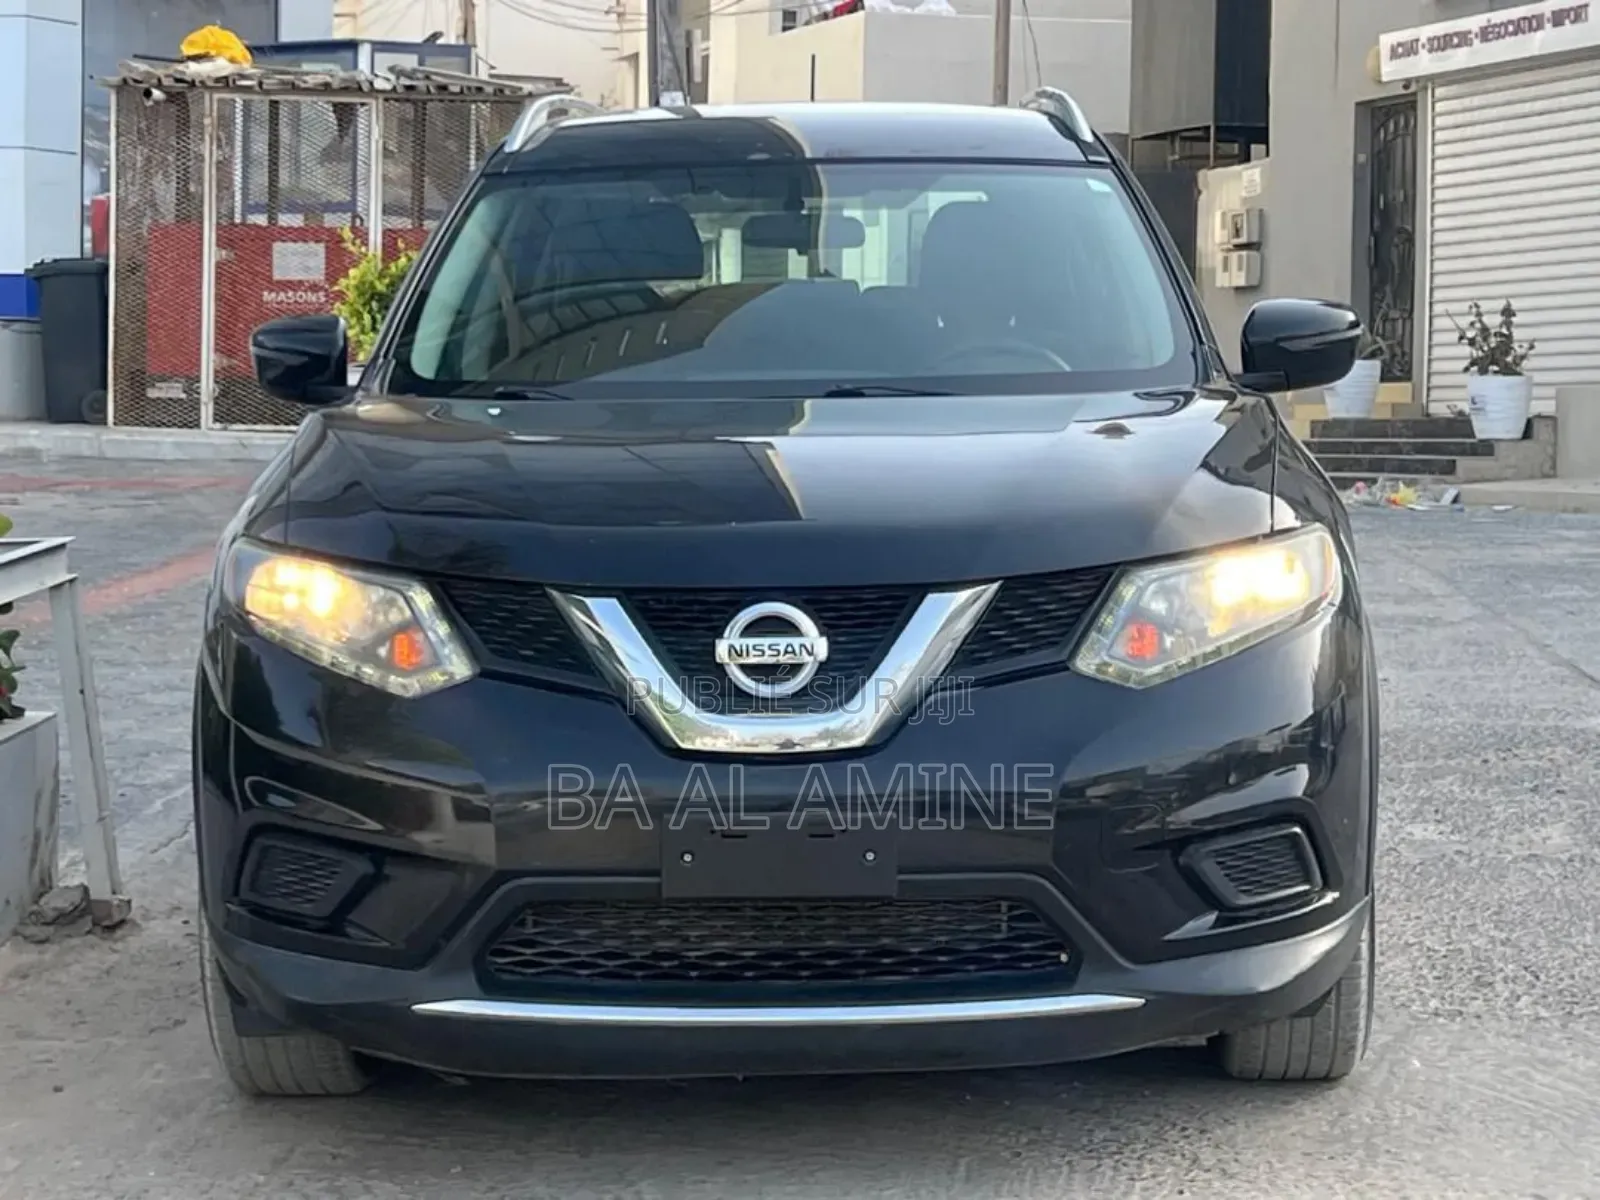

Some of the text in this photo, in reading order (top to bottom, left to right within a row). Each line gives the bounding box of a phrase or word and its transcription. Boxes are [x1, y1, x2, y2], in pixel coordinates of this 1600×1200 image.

[1426, 29, 1473, 54] SOURCING
[262, 291, 327, 303] MASONS
[728, 642, 814, 658] NISSAN
